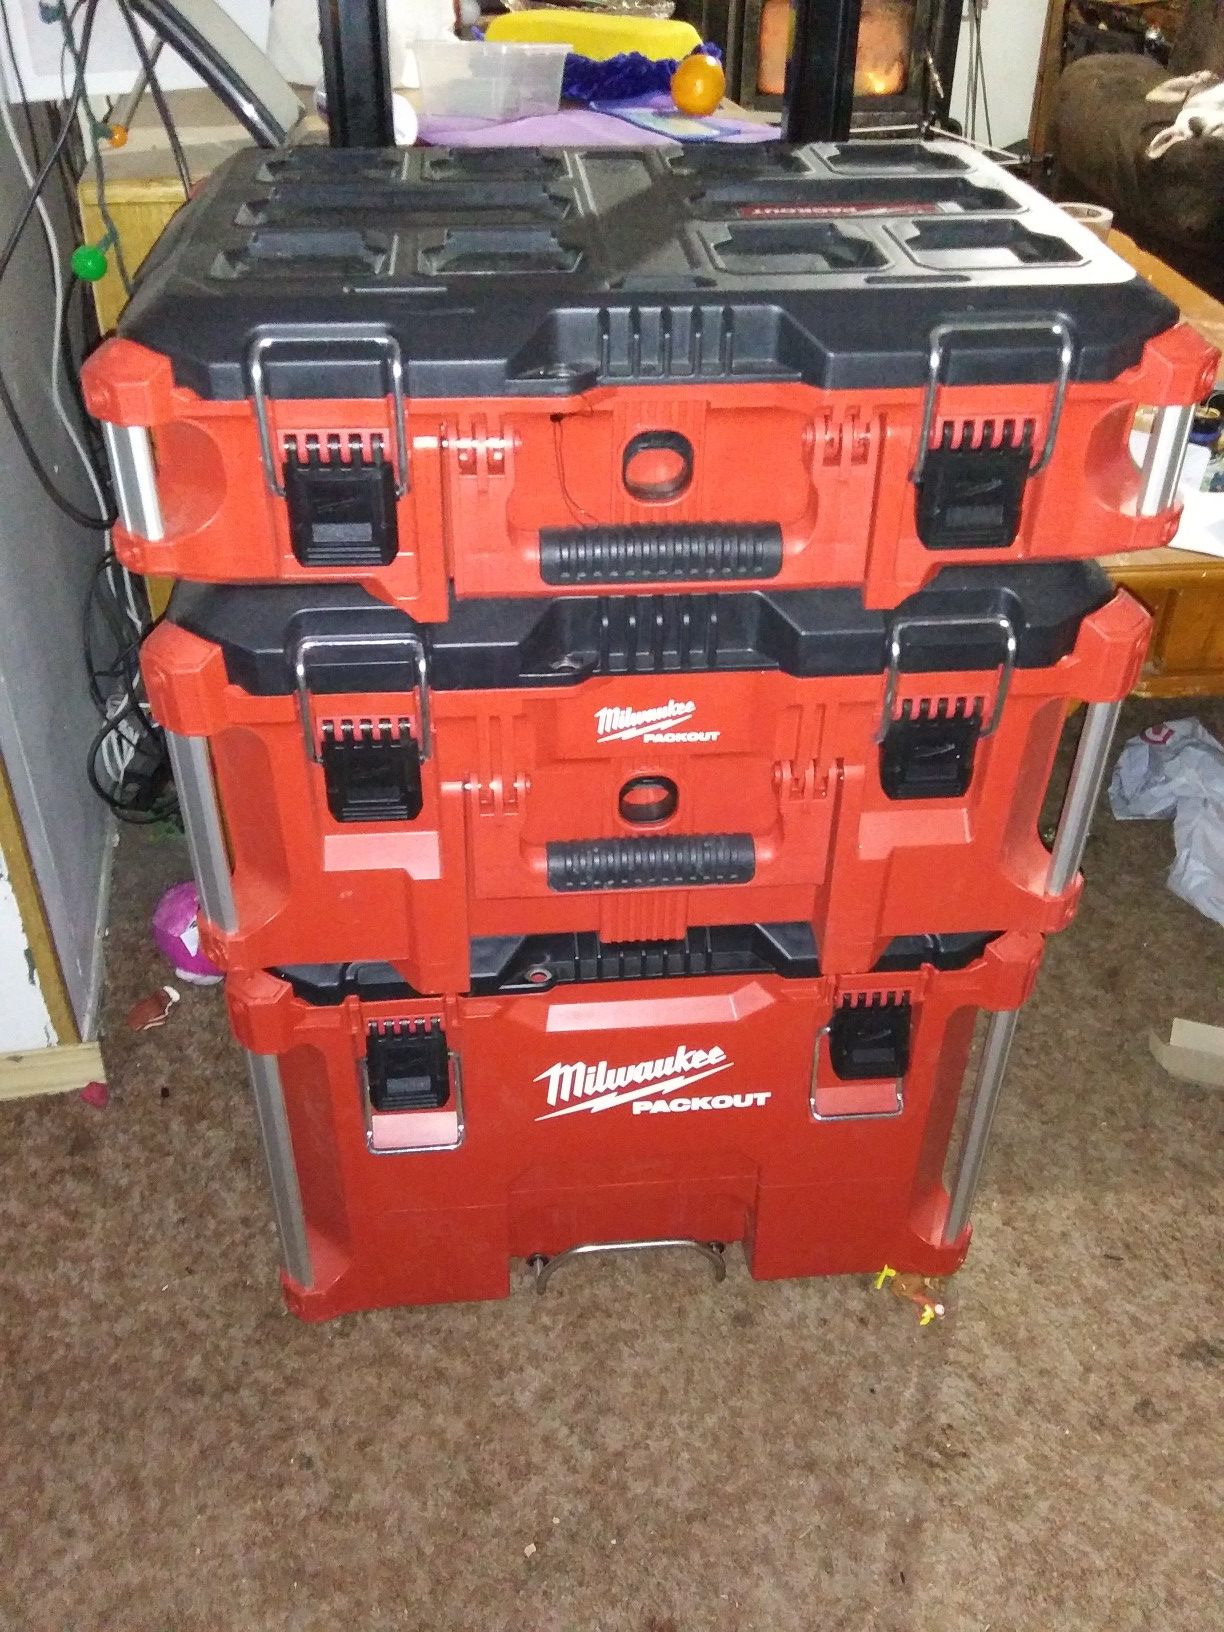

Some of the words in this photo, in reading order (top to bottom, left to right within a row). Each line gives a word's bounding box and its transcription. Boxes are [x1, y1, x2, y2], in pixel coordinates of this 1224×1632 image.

[594, 699, 696, 735] Milwaukee
[643, 731, 720, 743] PACKOUT
[533, 1045, 727, 1106] Milwaukee
[632, 1092, 771, 1114] PACKOUT
